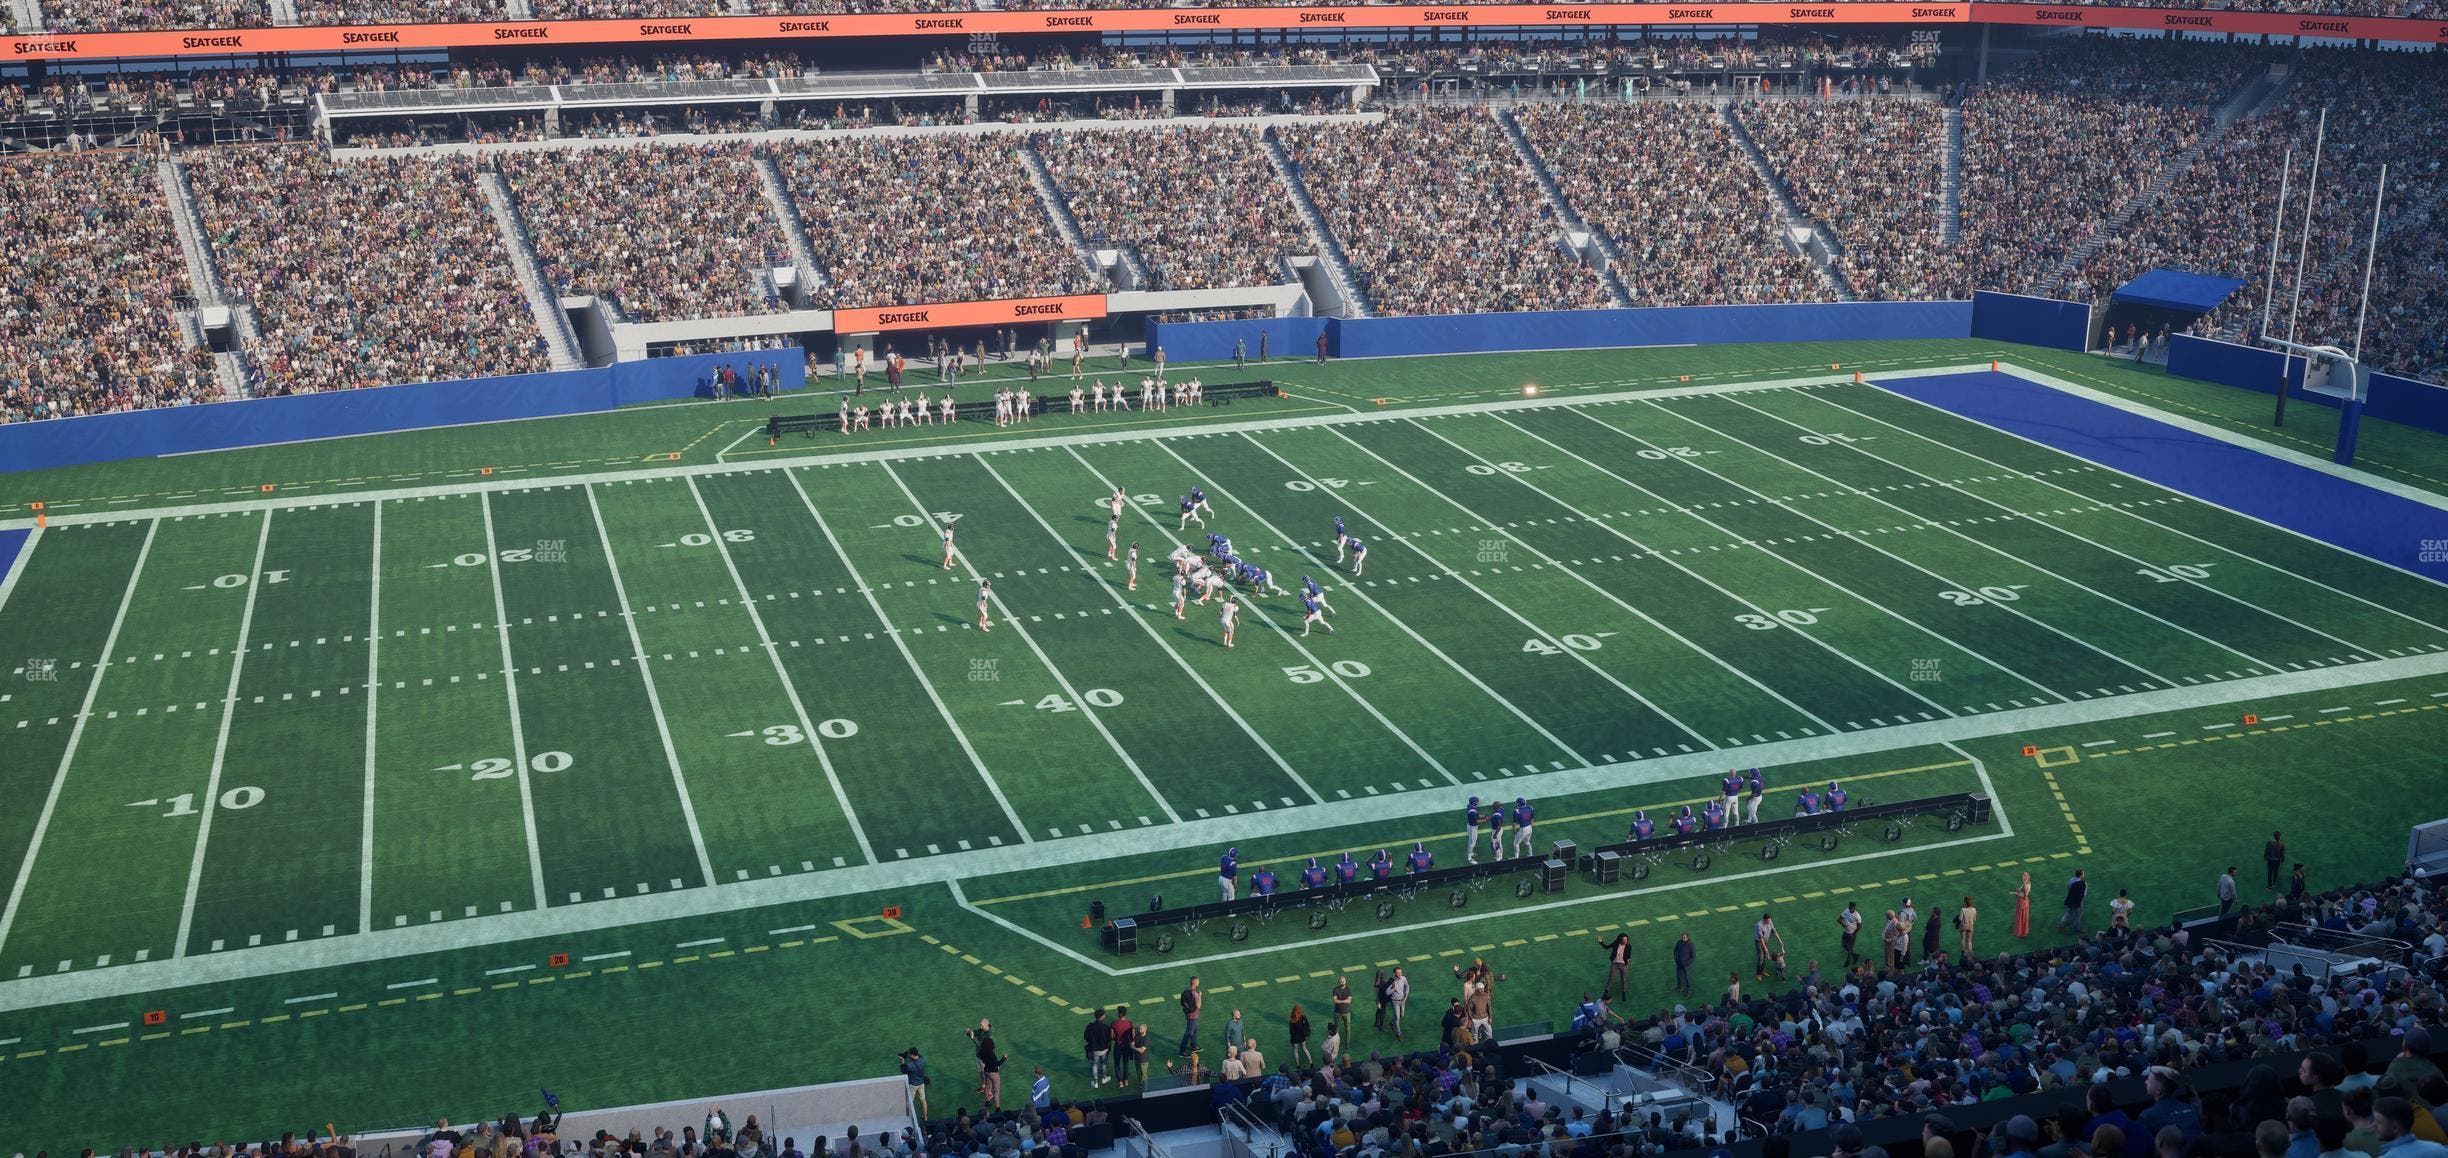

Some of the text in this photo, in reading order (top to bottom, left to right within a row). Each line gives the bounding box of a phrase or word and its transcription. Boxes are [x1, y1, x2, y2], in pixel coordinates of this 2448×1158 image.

[1301, 13, 1345, 24] SEATGEEK
[1425, 11, 1468, 22] SEATGEEK
[1547, 10, 1590, 21] SEATGEEK
[1670, 9, 1713, 19] SEATGEEK
[1791, 9, 1834, 18] SEATGEEK
[1912, 8, 1956, 18] SEATGEEK
[2036, 10, 2083, 21] SEATGEEK
[916, 20, 962, 30] SEATGEEK
[1047, 17, 1093, 28] SEATGEEK
[1175, 15, 1220, 25] SEATGEEK
[2164, 15, 2213, 27] SEATGEEK
[641, 25, 691, 36] SEATGEEK
[780, 22, 829, 33] SEATGEEK
[2301, 20, 2349, 32] SEATGEEK
[344, 32, 399, 44] SEATGEEK
[495, 27, 547, 39] SEATGEEK
[15, 42, 77, 54] SEATGEEK
[184, 37, 242, 49] SEATGEEK
[880, 303, 1063, 325] SEATGEEK SEATGEEK
[1282, 661, 1371, 683] 50
[1035, 689, 1124, 712] 40
[763, 719, 859, 746] 30
[471, 752, 574, 780] 20
[162, 787, 265, 818] 10
[554, 956, 564, 965] 20
[150, 1012, 159, 1022] 10
